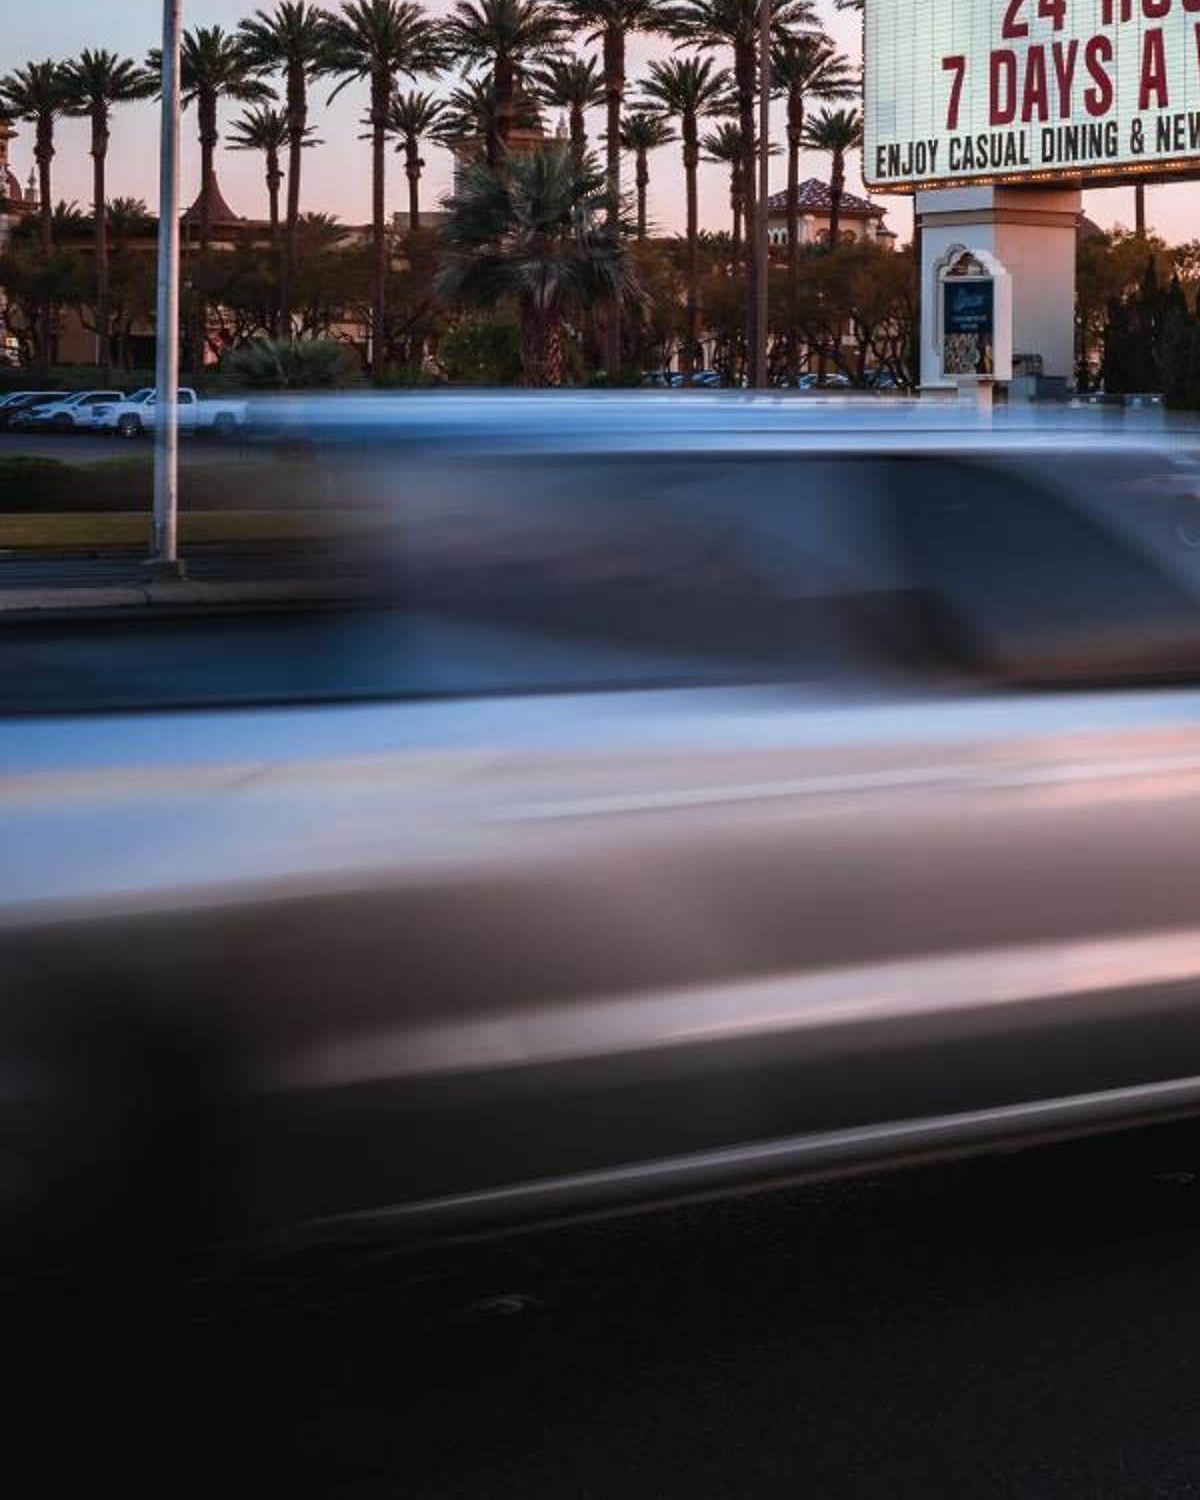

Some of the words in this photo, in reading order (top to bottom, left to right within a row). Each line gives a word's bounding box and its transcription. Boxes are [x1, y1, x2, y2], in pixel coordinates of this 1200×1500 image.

[941, 56, 966, 130] 7
[989, 34, 1113, 126] DAYS
[1138, 27, 1168, 110] A
[875, 139, 939, 178] ENJOY
[949, 130, 1029, 171] CASUAL
[1041, 120, 1118, 163] DINING
[1130, 118, 1145, 155] &
